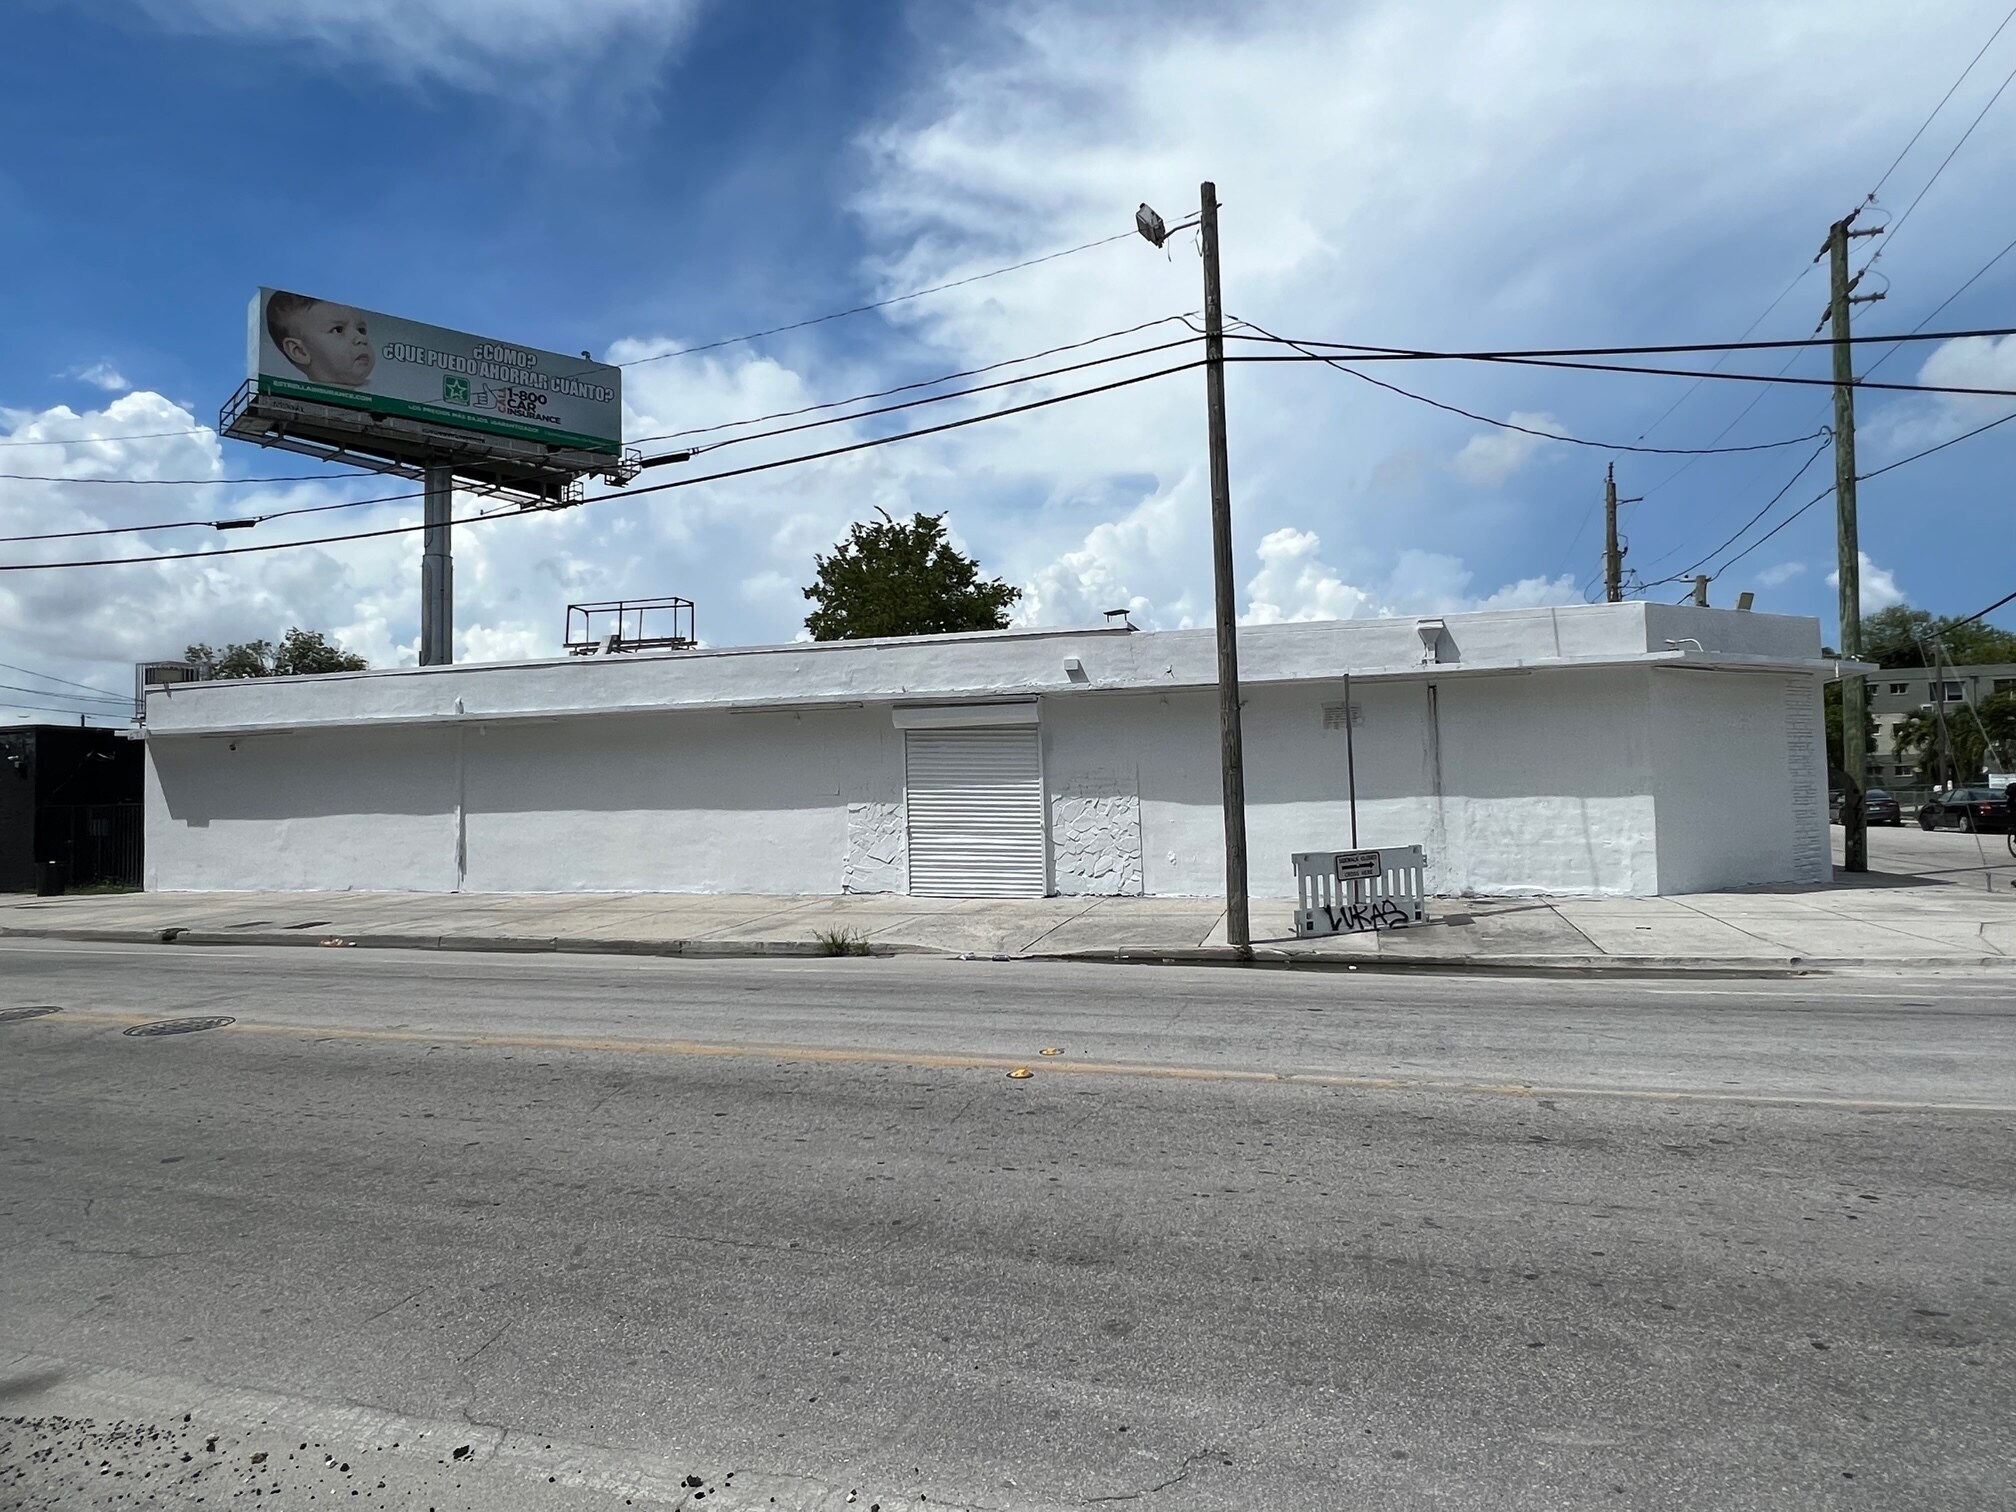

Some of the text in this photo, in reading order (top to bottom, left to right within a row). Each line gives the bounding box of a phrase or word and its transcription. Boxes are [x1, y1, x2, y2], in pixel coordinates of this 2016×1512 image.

[474, 344, 537, 368] ¿CÓMO?
[383, 343, 614, 403] ¿QUE PUEDO AHORRAR CUÁNTO?
[508, 388, 547, 405] 1-800
[507, 398, 536, 413] CAR
[508, 408, 561, 424] INSURANCE
